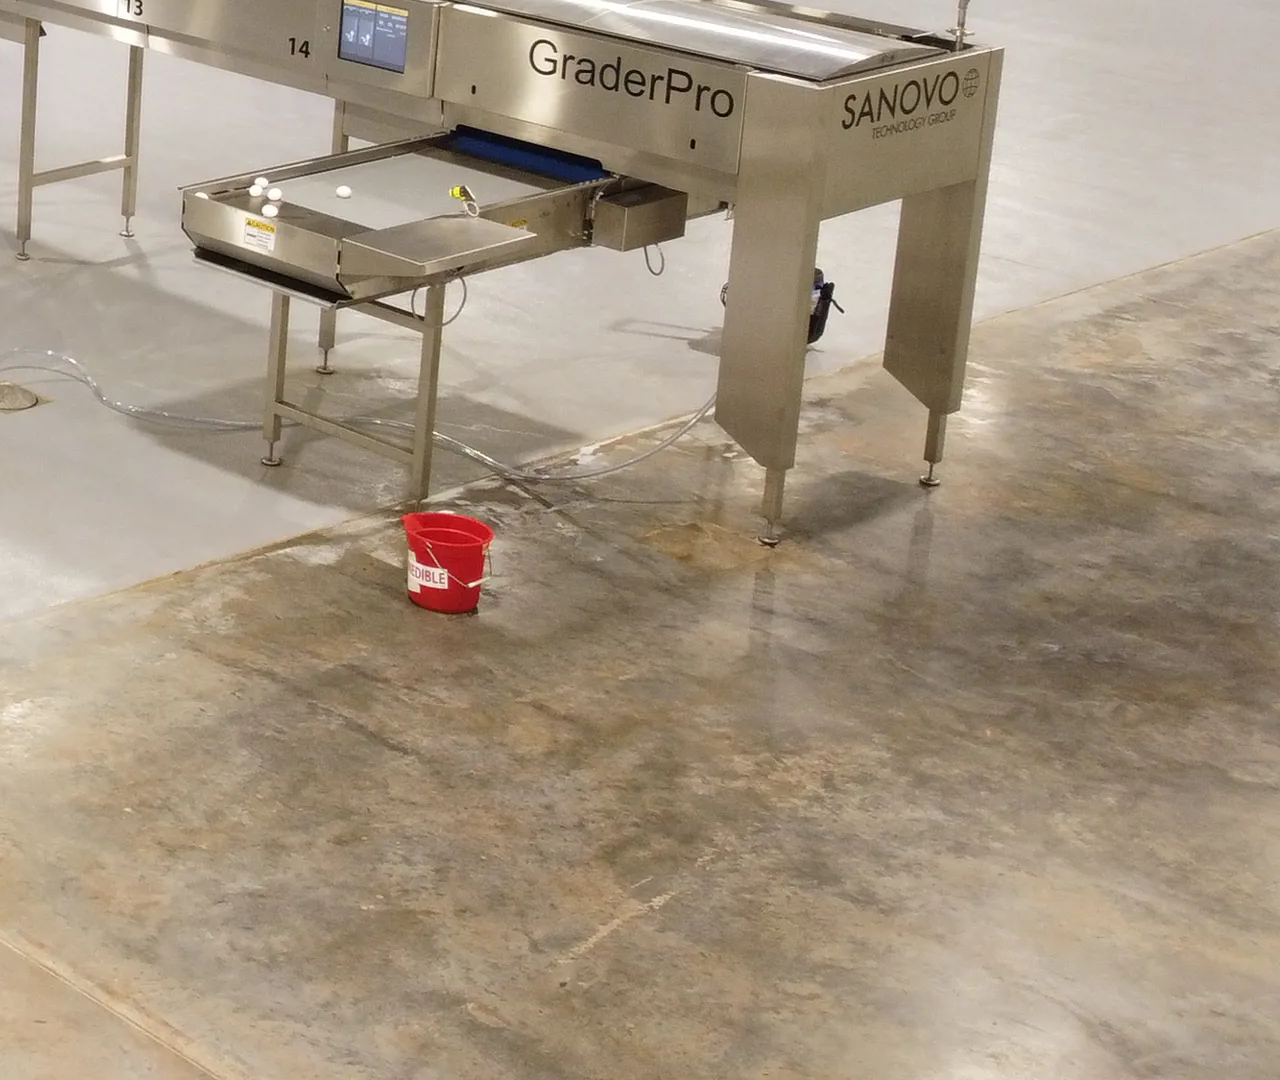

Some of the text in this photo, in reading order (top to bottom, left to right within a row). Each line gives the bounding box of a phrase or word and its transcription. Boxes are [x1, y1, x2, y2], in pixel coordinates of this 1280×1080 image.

[288, 37, 311, 58] 14
[528, 38, 735, 118] GraderPro
[841, 70, 960, 130] SANOVO
[871, 108, 957, 140] TECHNOLOGY GROUP
